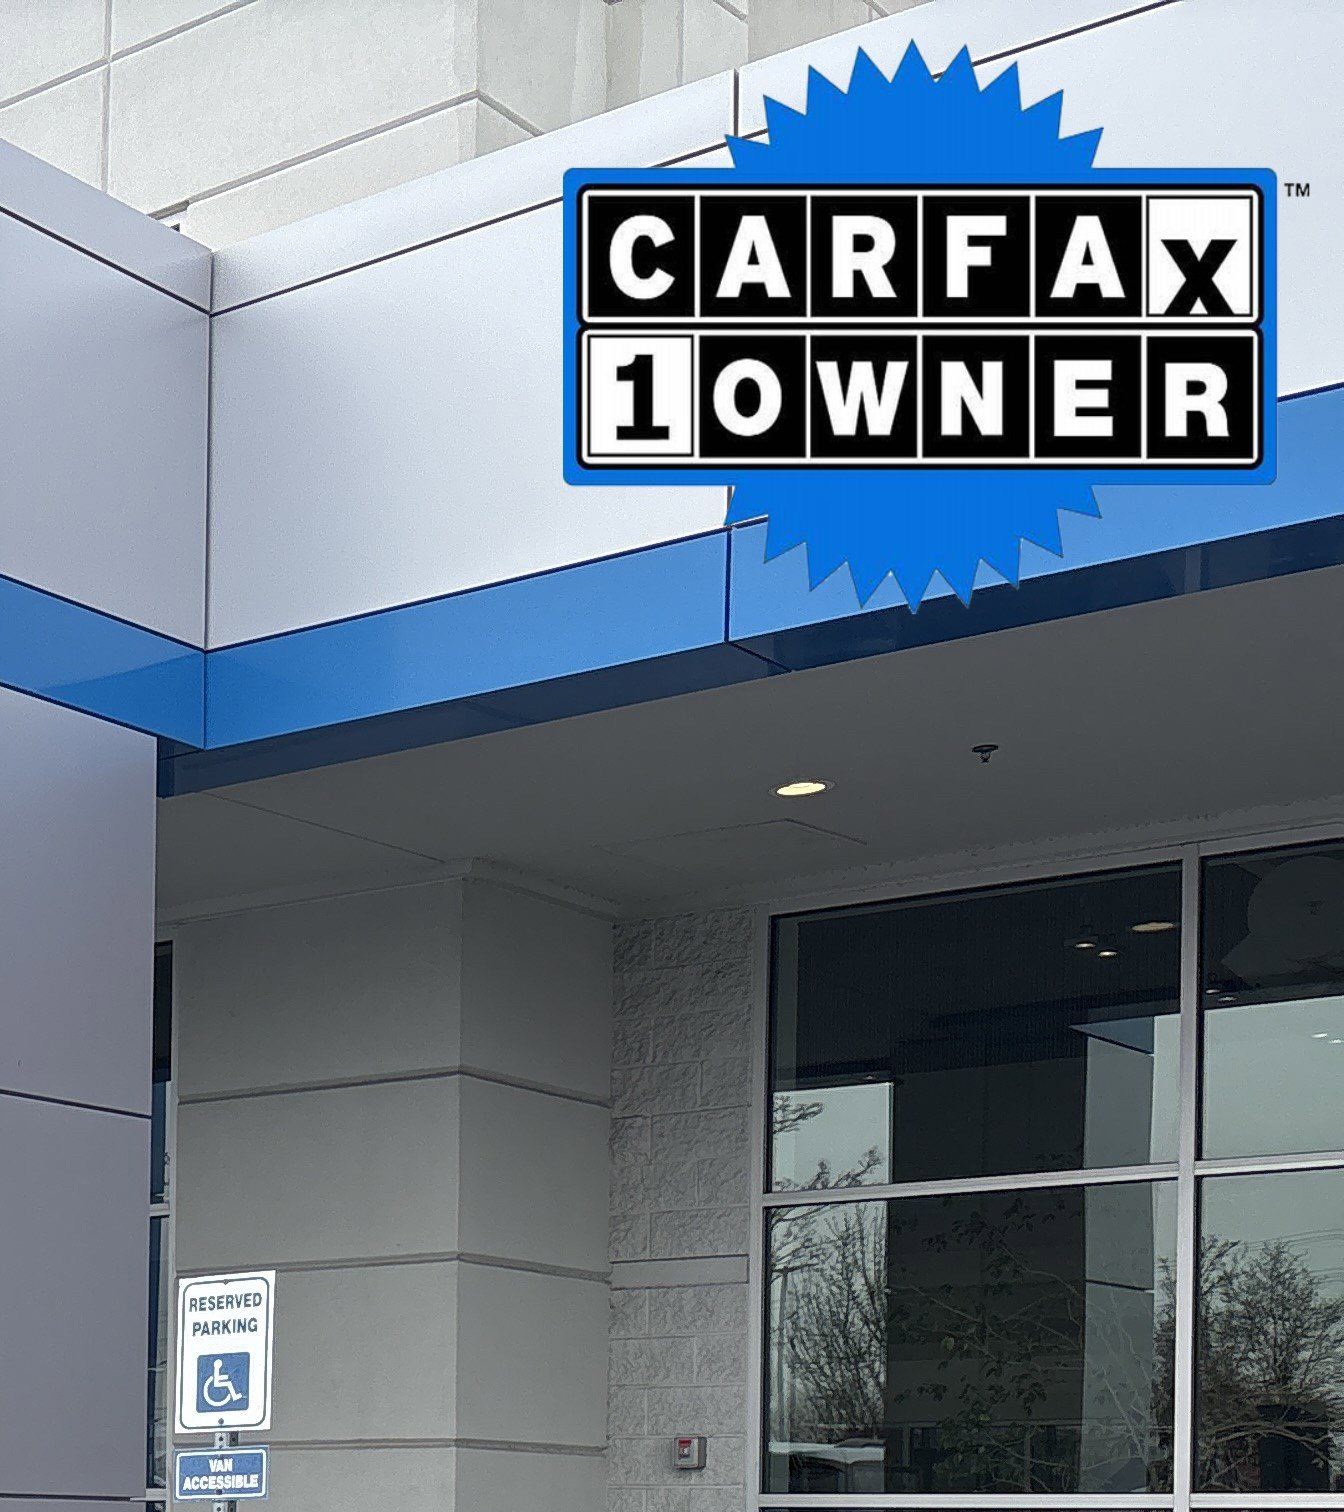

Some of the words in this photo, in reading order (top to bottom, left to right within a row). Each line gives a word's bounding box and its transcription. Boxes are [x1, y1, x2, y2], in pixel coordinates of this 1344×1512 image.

[188, 1292, 263, 1312] RESERVED
[192, 1317, 258, 1337] PARKING
[208, 1457, 234, 1473] VAN
[182, 1473, 259, 1491] ACCESSIBLE
